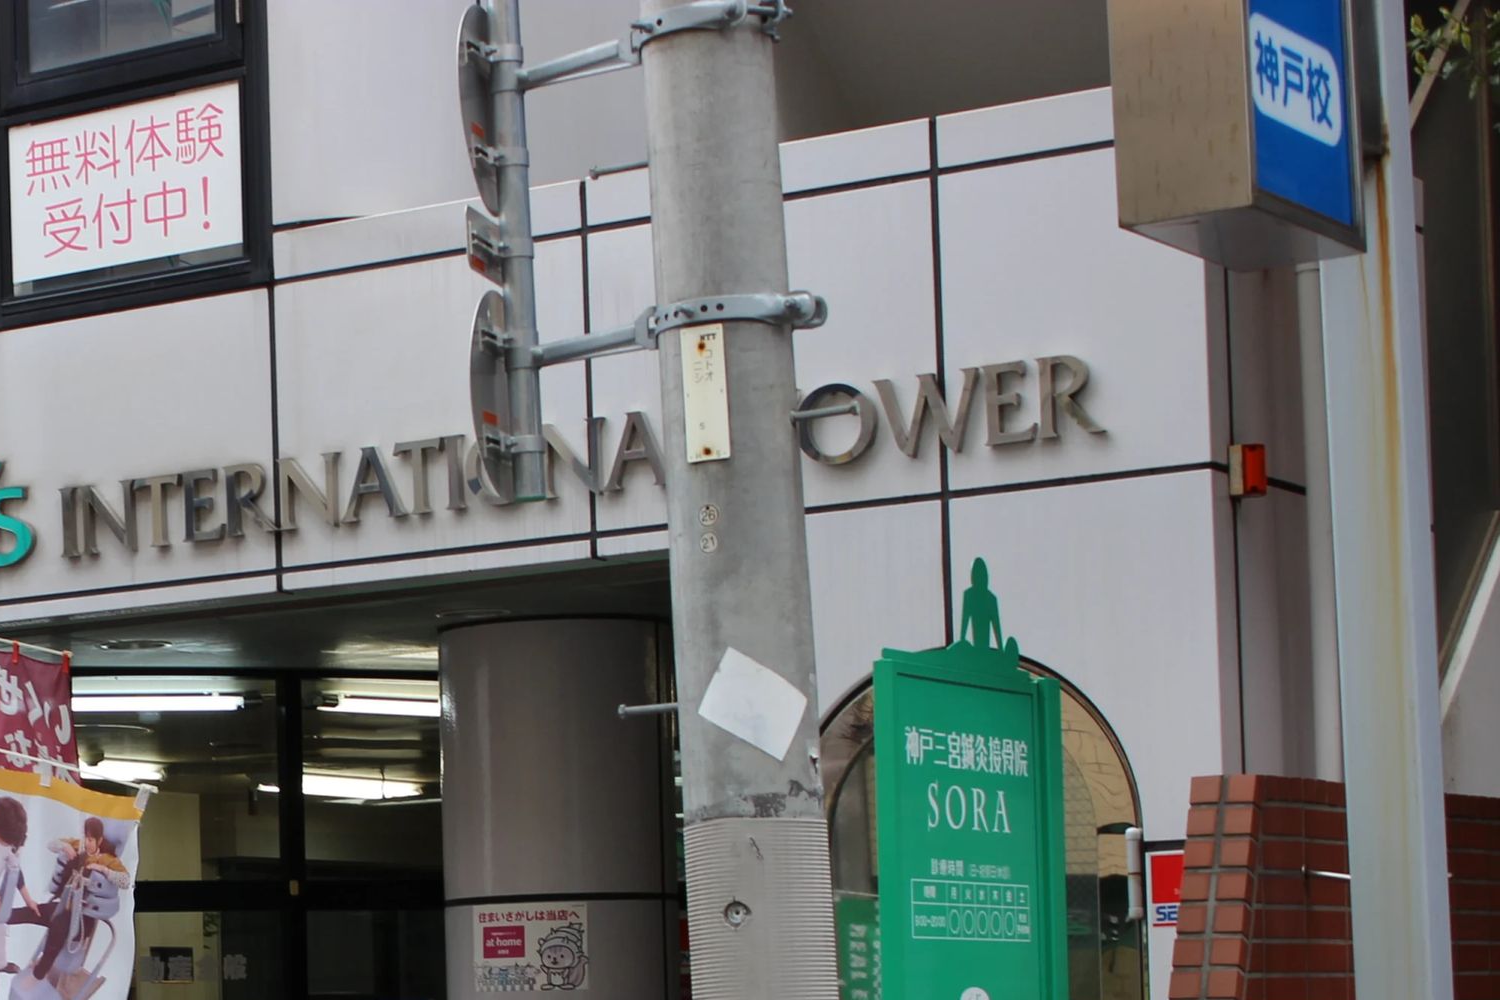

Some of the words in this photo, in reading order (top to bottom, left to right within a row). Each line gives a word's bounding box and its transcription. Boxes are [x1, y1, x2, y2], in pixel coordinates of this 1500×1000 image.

[1254, 30, 1333, 131] 神戸校
[24, 101, 227, 197] 無料体験
[41, 174, 216, 261] 受付中!
[700, 332, 717, 342] NTT
[58, 408, 666, 560] INTERNATINA
[798, 354, 1107, 467] OWER
[701, 509, 717, 524] 26
[701, 536, 717, 549] 21
[905, 724, 1028, 778] 神戸三宮鍼灸接骨院
[927, 779, 1011, 834] SORA
[478, 910, 581, 924] 住まいさがしは当店へ
